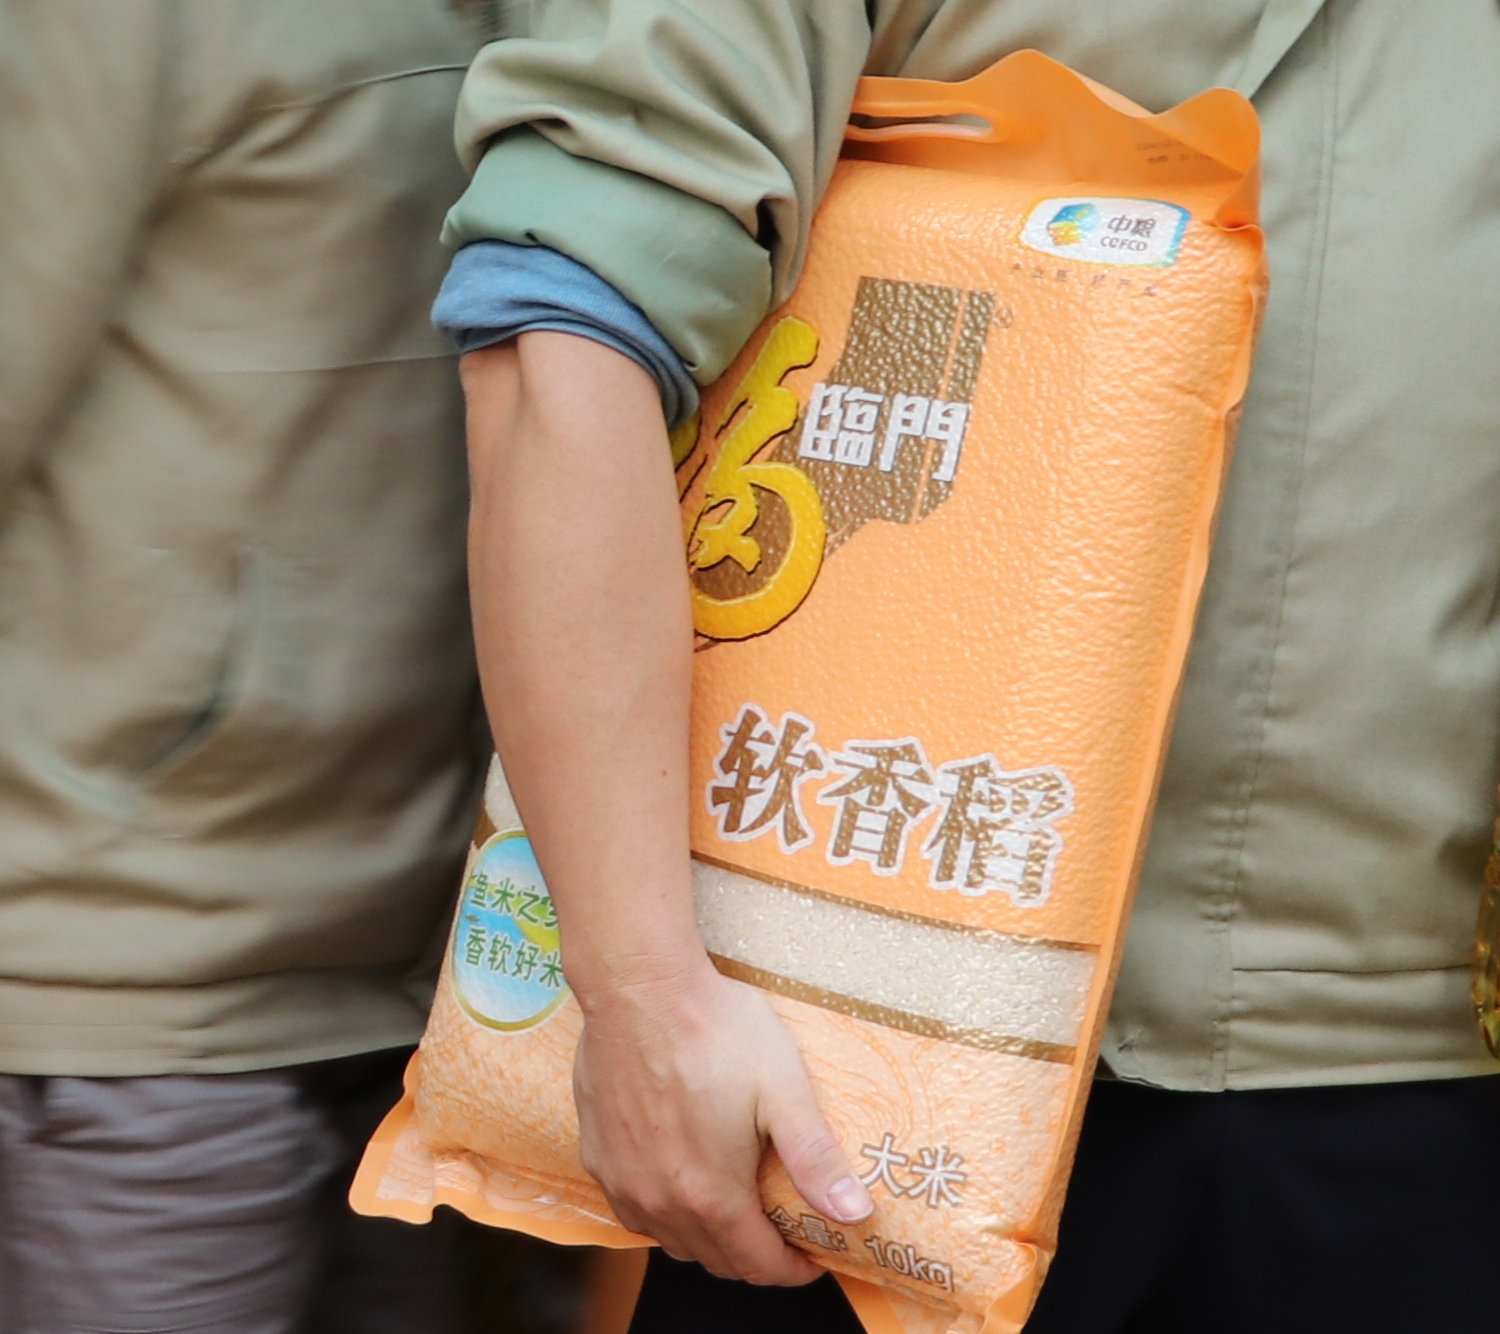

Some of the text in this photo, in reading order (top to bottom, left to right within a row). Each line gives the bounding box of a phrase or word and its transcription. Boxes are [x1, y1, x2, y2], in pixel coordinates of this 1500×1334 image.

[799, 382, 969, 481] 臨門
[705, 702, 1075, 908] 软香稻
[859, 1131, 968, 1209] 大米
[864, 1234, 956, 1293] 10kg
